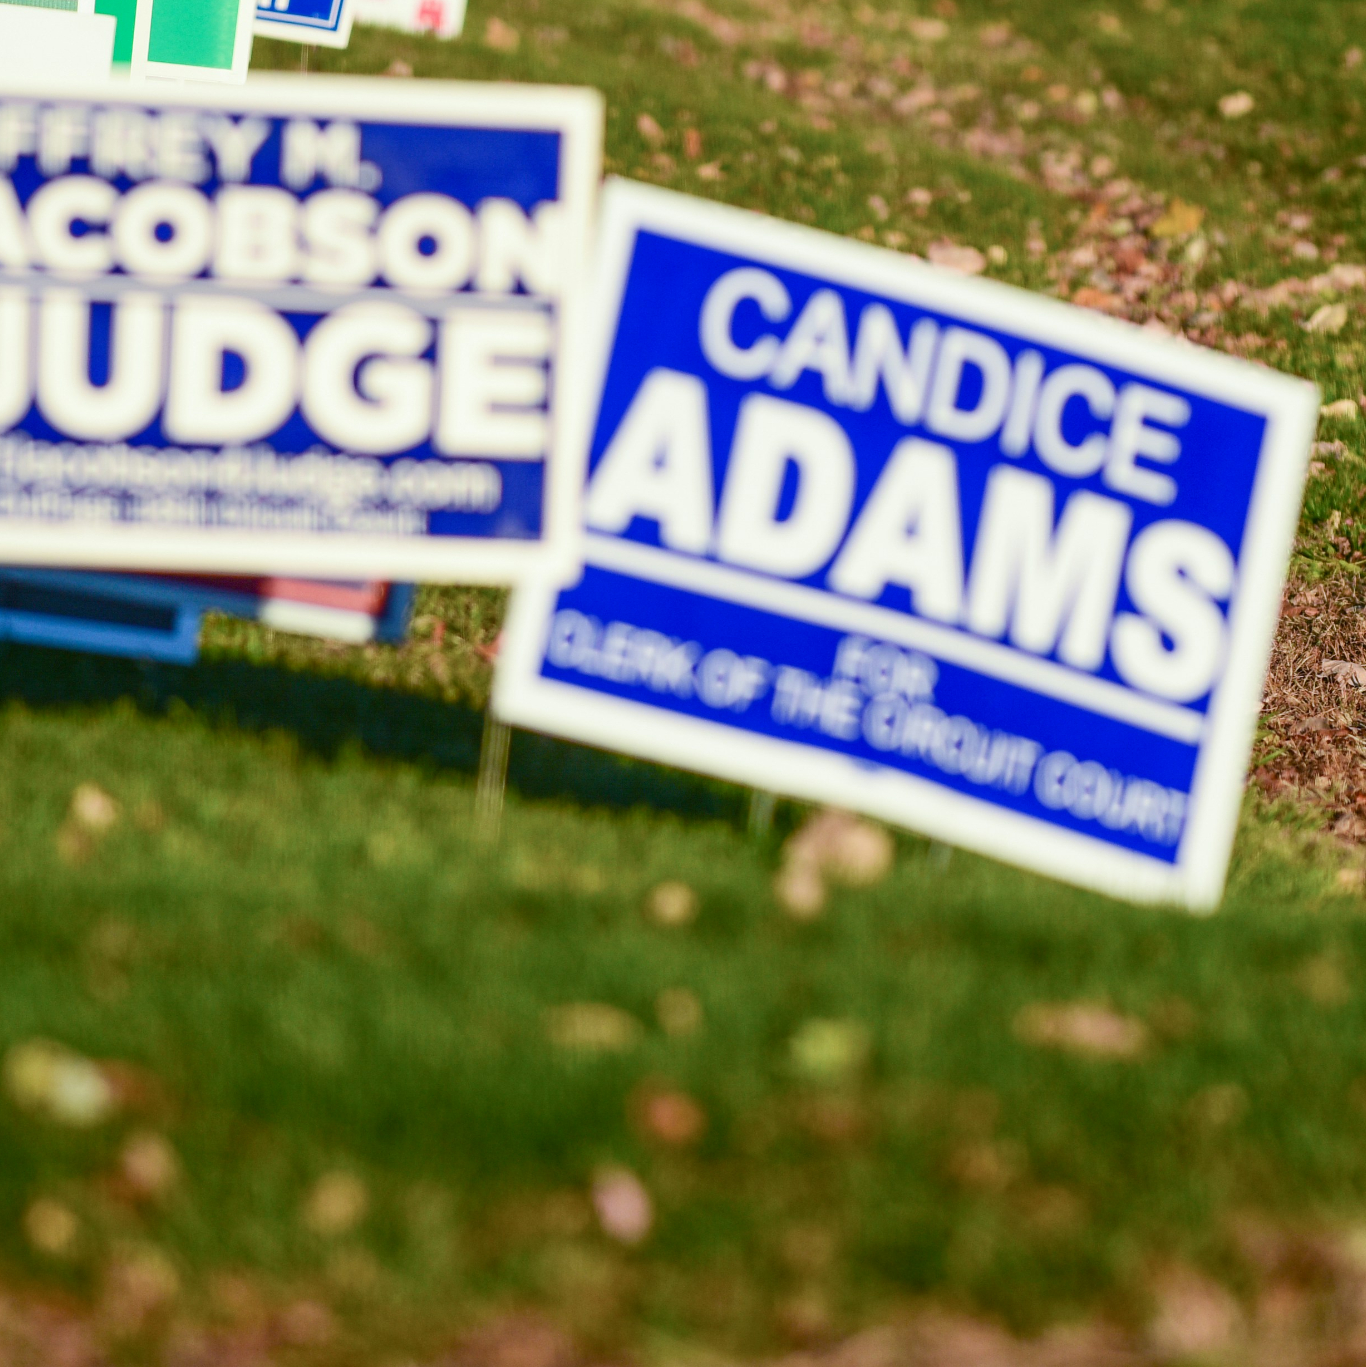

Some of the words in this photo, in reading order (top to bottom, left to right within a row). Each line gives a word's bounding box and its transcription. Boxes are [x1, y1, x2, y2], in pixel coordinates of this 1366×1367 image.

[282, 116, 382, 192] M.
[700, 267, 1192, 506] CANDICE
[583, 366, 1237, 705] ADAMS
[546, 608, 704, 699] CLERK
[695, 647, 774, 712] OF
[770, 664, 864, 740] THE
[861, 691, 1043, 796] CIRCUIT
[1035, 749, 1190, 847] COURT
[835, 634, 938, 702] FOR
